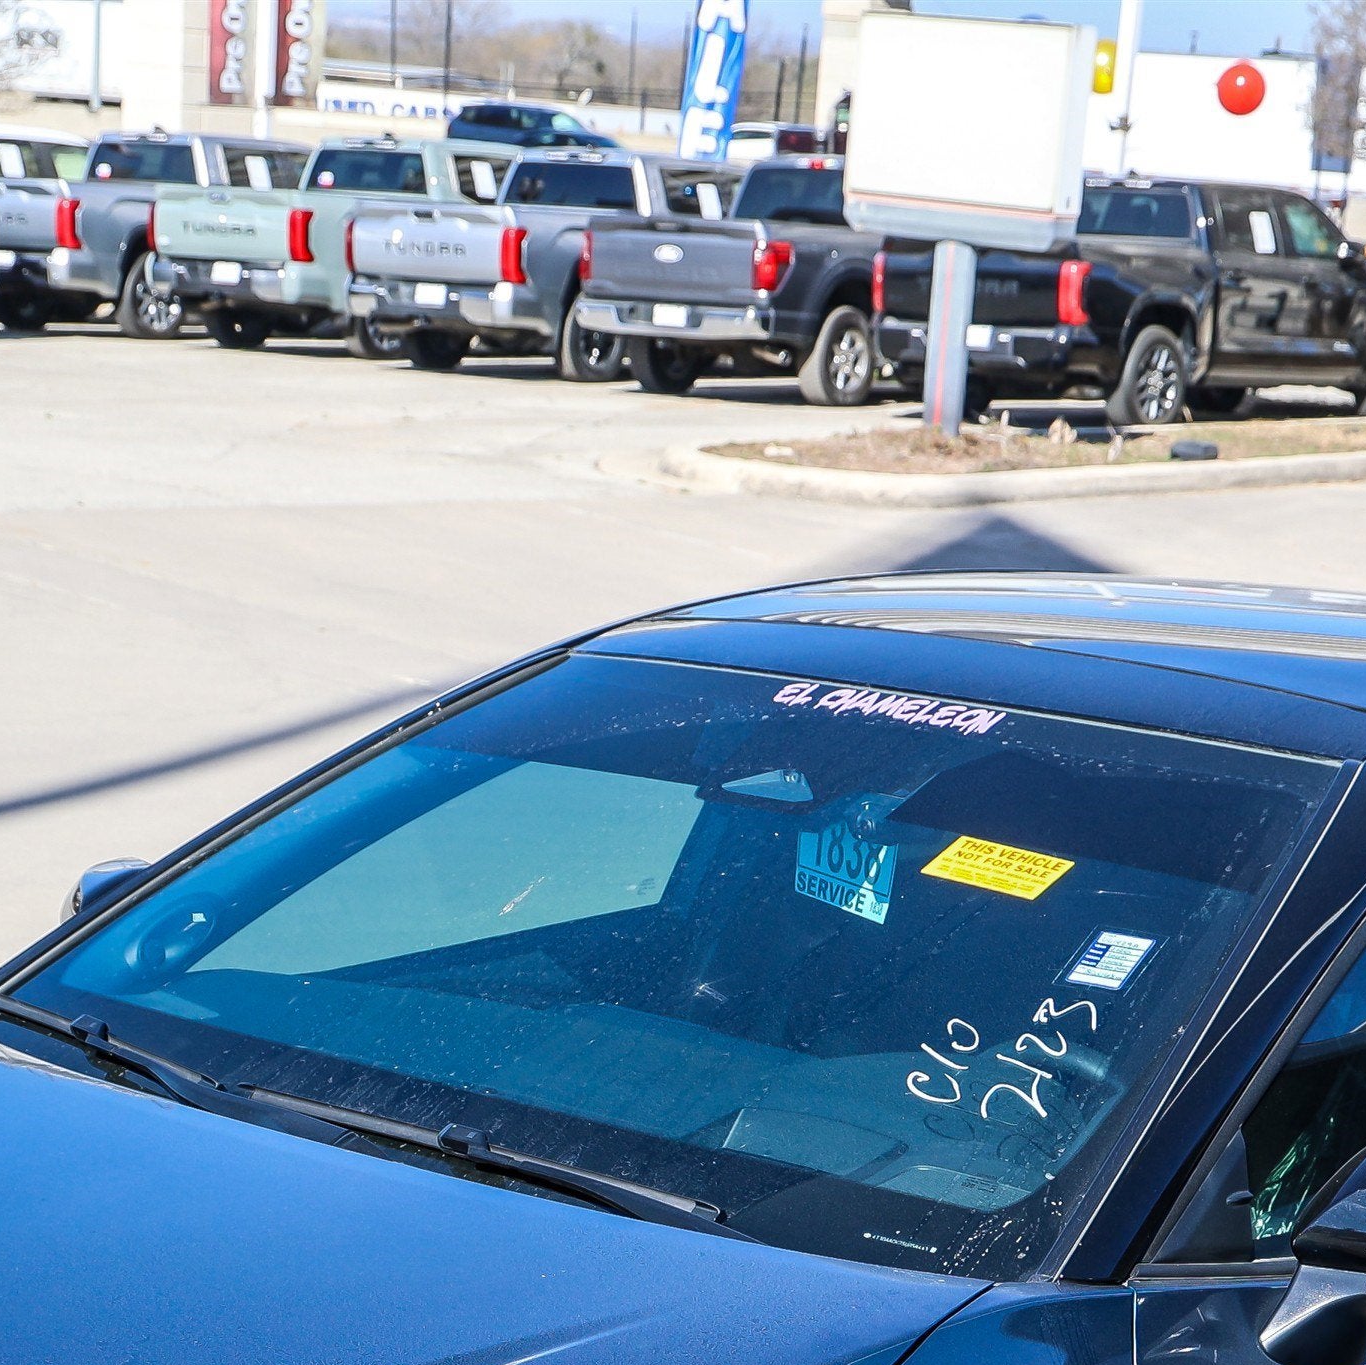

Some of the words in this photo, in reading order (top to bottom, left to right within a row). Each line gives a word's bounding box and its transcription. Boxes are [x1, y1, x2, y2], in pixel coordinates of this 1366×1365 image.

[773, 682, 821, 707] EL
[813, 689, 1008, 736] CHAMELEON
[953, 850, 983, 862] NOT
[983, 857, 1014, 869] FOR
[1014, 864, 1051, 879] SALE
[960, 840, 997, 855] THIS
[999, 848, 1066, 872] VEHICLE
[796, 870, 866, 914] SERVICE
